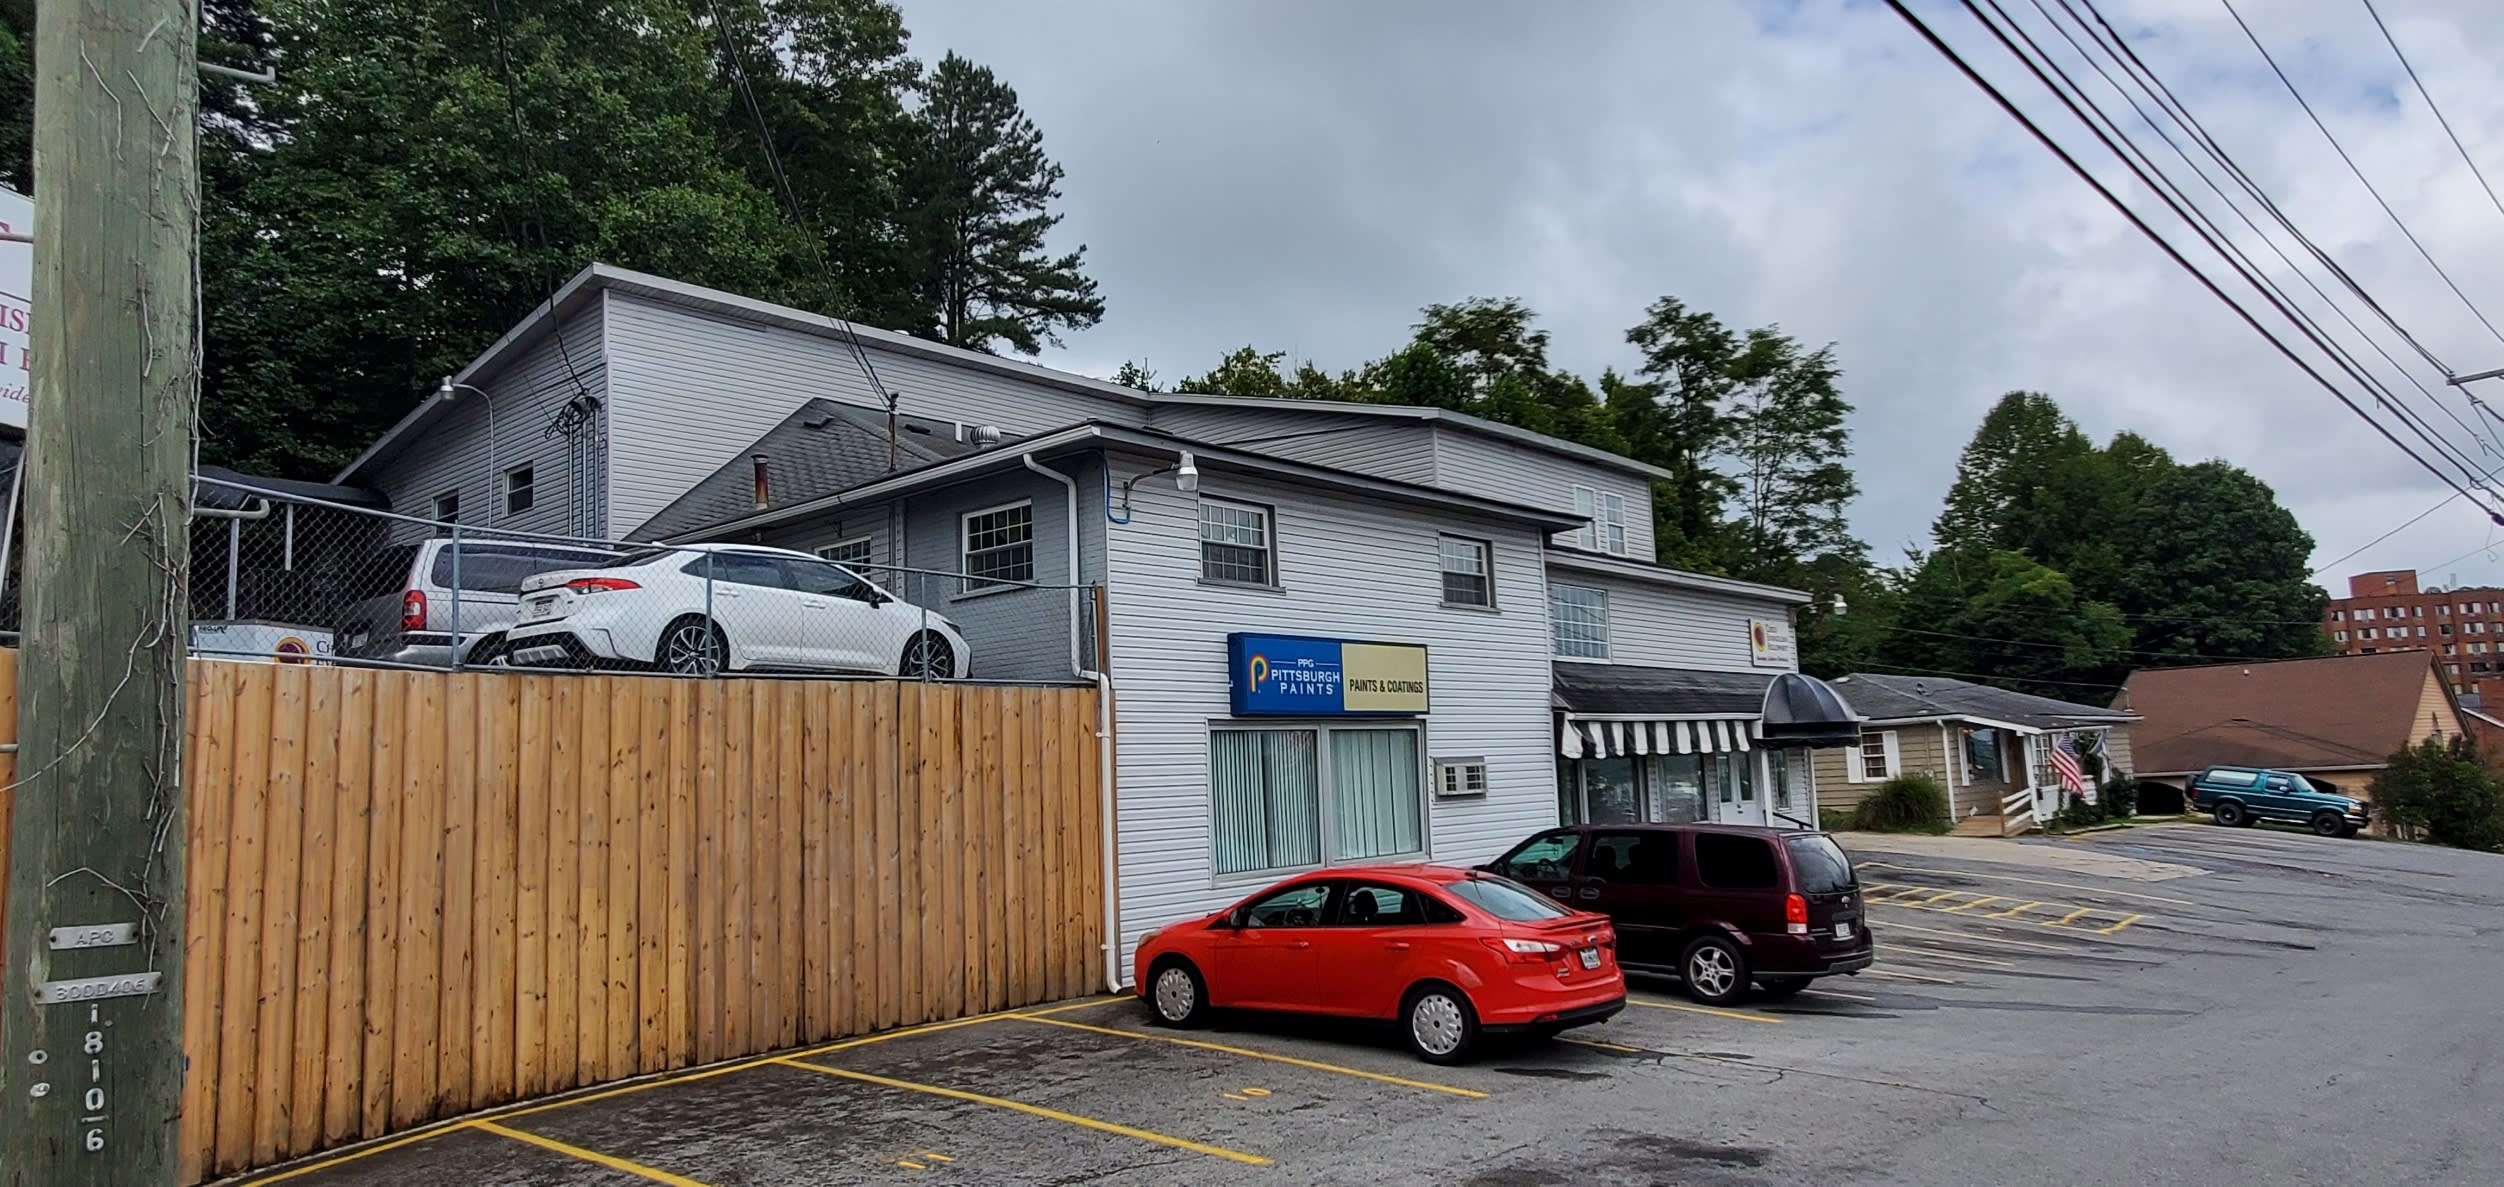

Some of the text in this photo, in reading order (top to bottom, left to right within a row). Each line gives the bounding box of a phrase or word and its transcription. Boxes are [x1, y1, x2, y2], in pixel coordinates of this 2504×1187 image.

[1297, 658, 1315, 668] PPG
[1271, 669, 1340, 683] PITTSBURGH
[1280, 682, 1334, 695] PAINTS
[1349, 679, 1424, 693] PAINTS & COATINGS
[75, 930, 114, 946] APC
